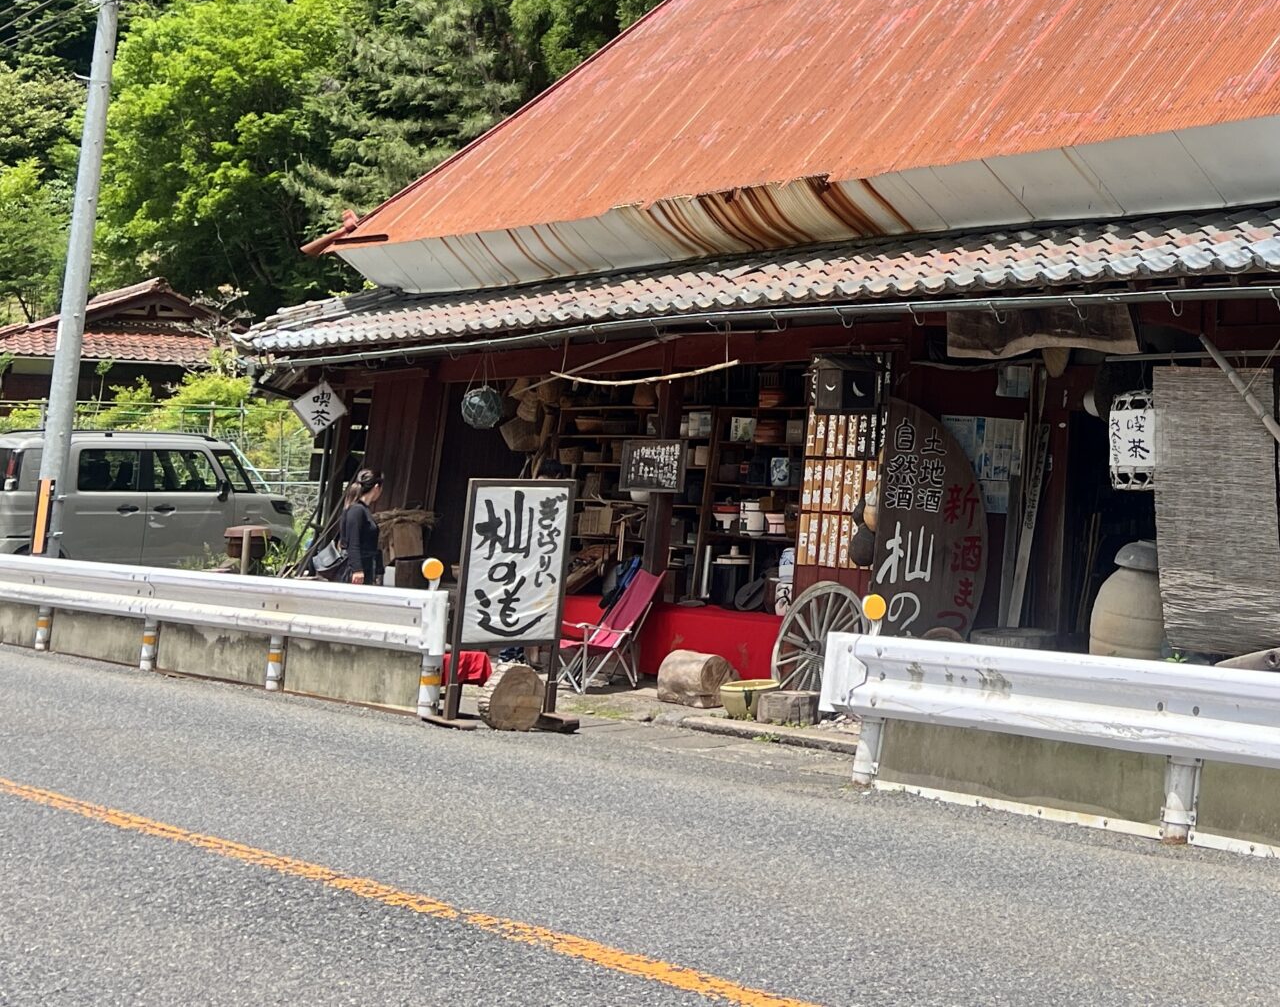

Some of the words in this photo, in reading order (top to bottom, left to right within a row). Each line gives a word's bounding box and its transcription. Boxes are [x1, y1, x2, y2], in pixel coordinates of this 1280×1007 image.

[311, 390, 331, 426] 喫茶
[1126, 415, 1150, 460] 喫茶
[885, 417, 919, 511] 自然酒
[915, 427, 947, 513] 土地酒
[876, 521, 935, 636] 杣の
